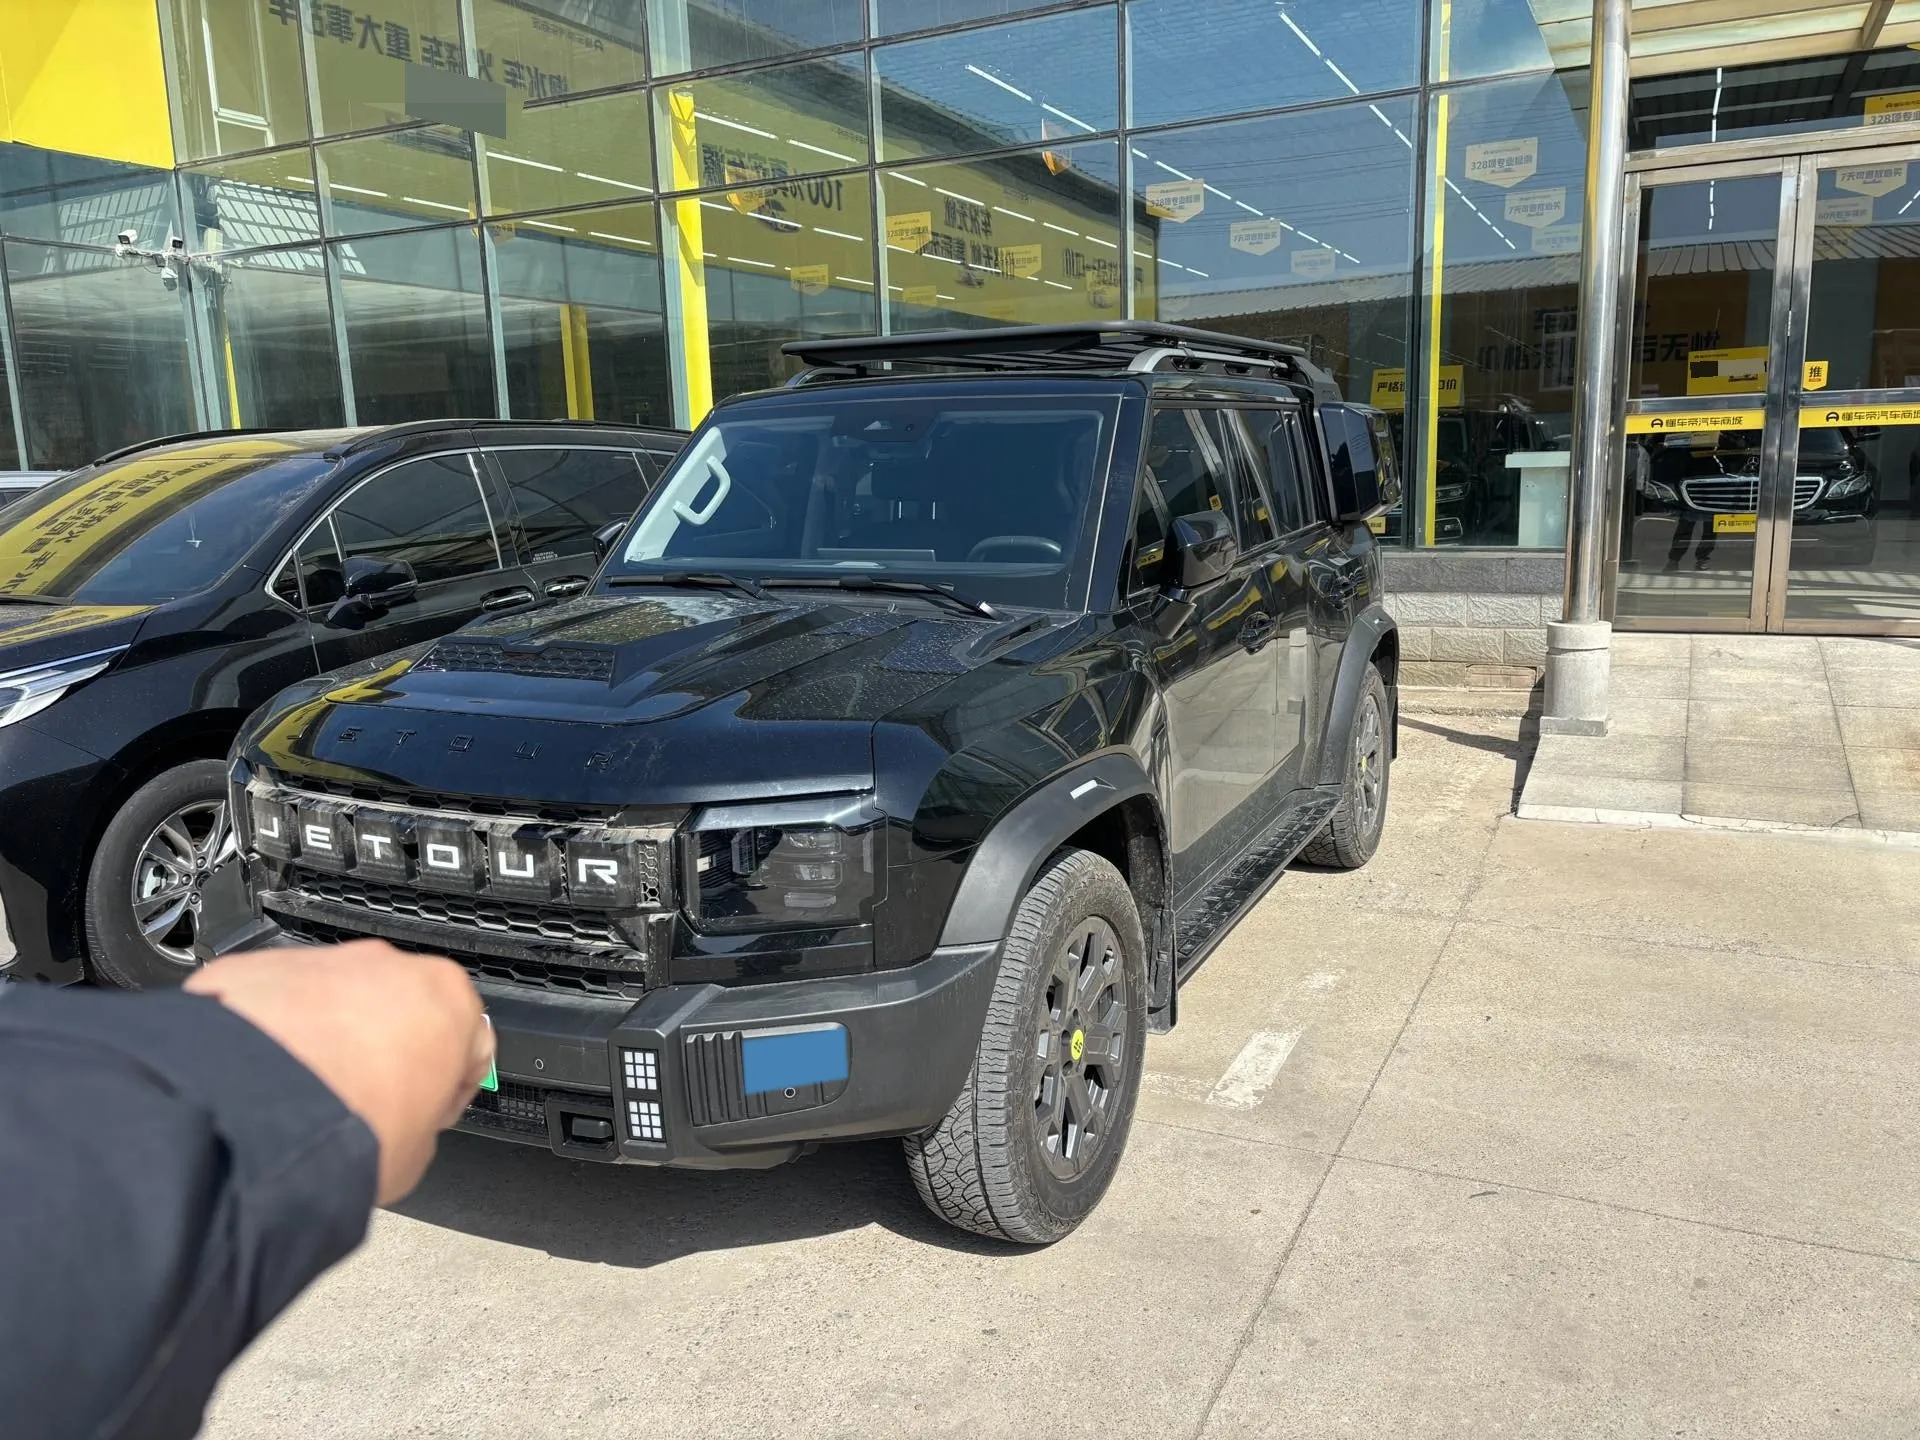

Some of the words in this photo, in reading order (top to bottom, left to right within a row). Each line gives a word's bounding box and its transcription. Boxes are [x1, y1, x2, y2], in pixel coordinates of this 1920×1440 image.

[1808, 365, 1823, 379] 推
[1665, 415, 1744, 429] 懂车帝汽车商城
[259, 817, 619, 885] JETOUR
